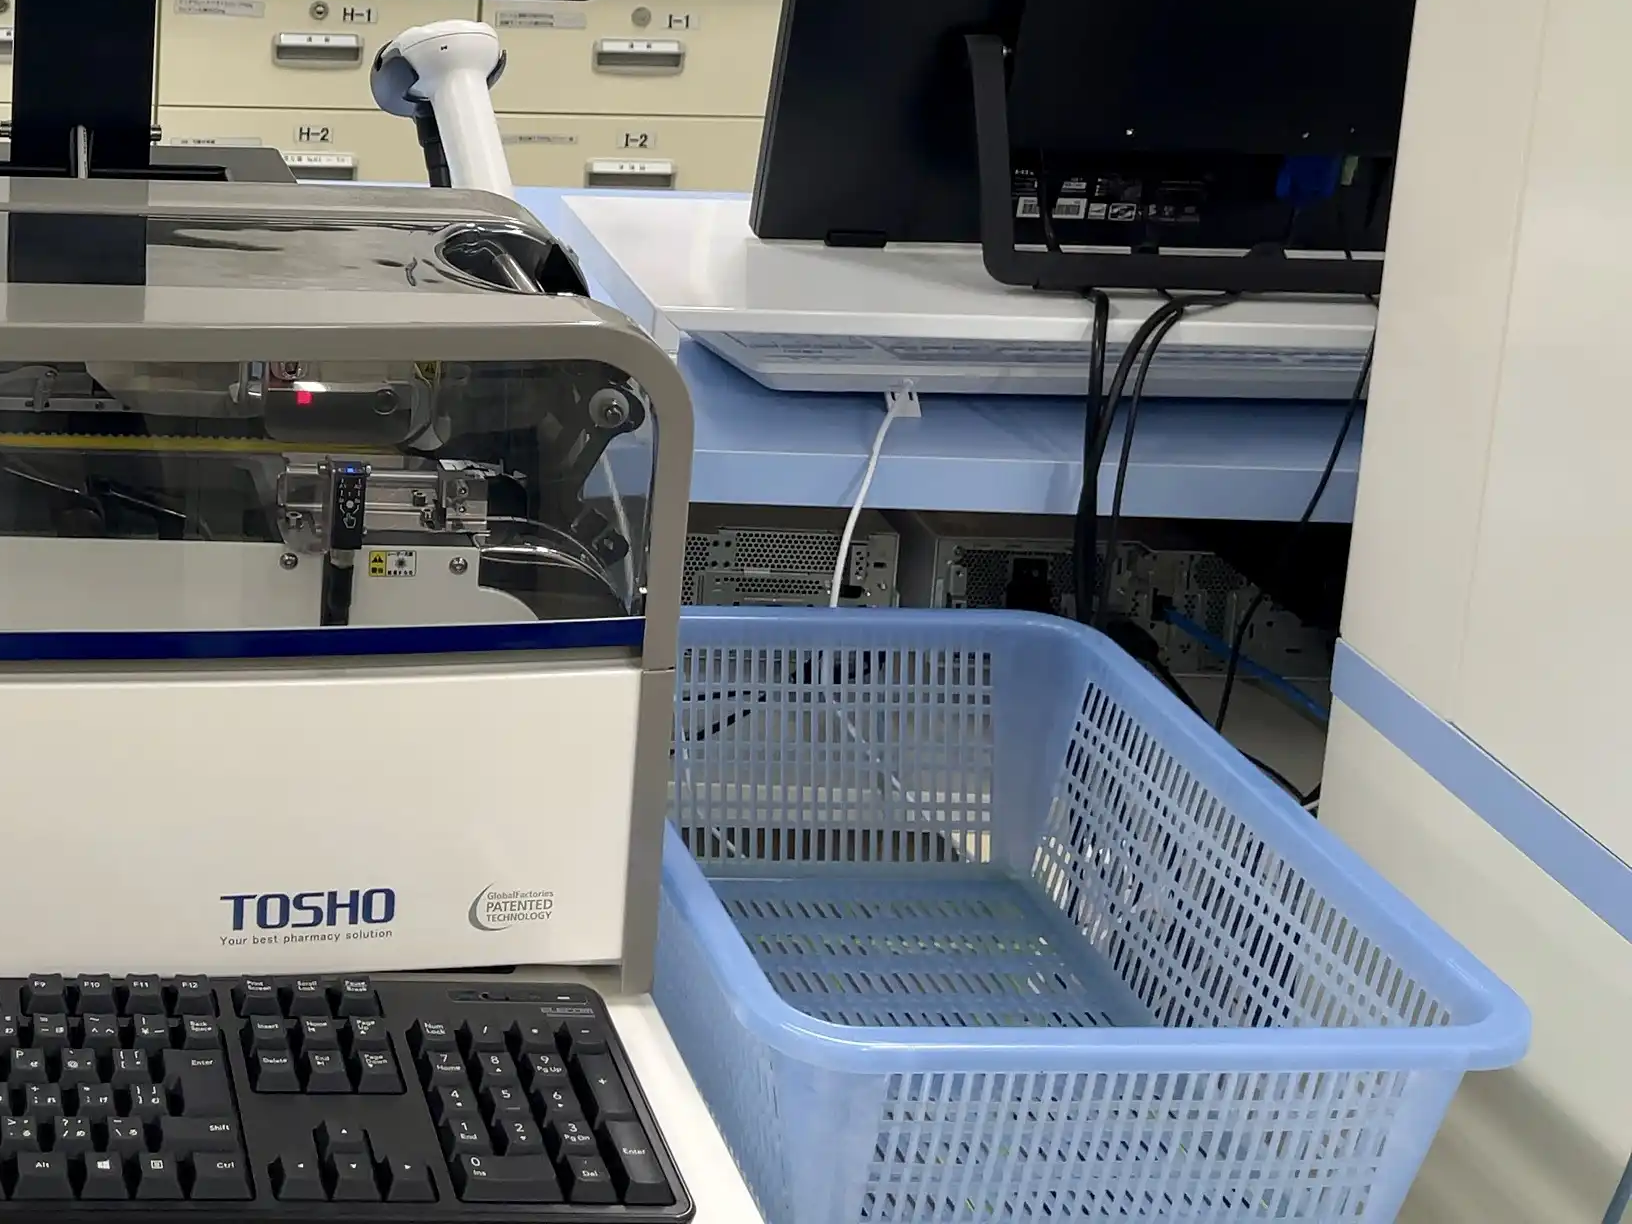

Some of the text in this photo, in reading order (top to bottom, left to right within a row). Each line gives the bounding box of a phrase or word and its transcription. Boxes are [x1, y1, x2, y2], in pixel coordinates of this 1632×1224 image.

[343, 8, 371, 22] H-1
[668, 14, 689, 28] I-1
[299, 127, 329, 141] H-2
[624, 133, 648, 148] I-2
[487, 890, 554, 900] GlobalFactories
[220, 888, 396, 931] TOSHO
[486, 899, 553, 912] PATENTED
[486, 911, 552, 922] TECHNOLOGY
[220, 929, 393, 945] Your best pharmacy solution
[16, 1050, 24, 1059] P
[440, 1054, 447, 1062] 7
[491, 1056, 499, 1064] 8
[540, 1056, 549, 1064] 9
[217, 1161, 234, 1169] Ctrl
